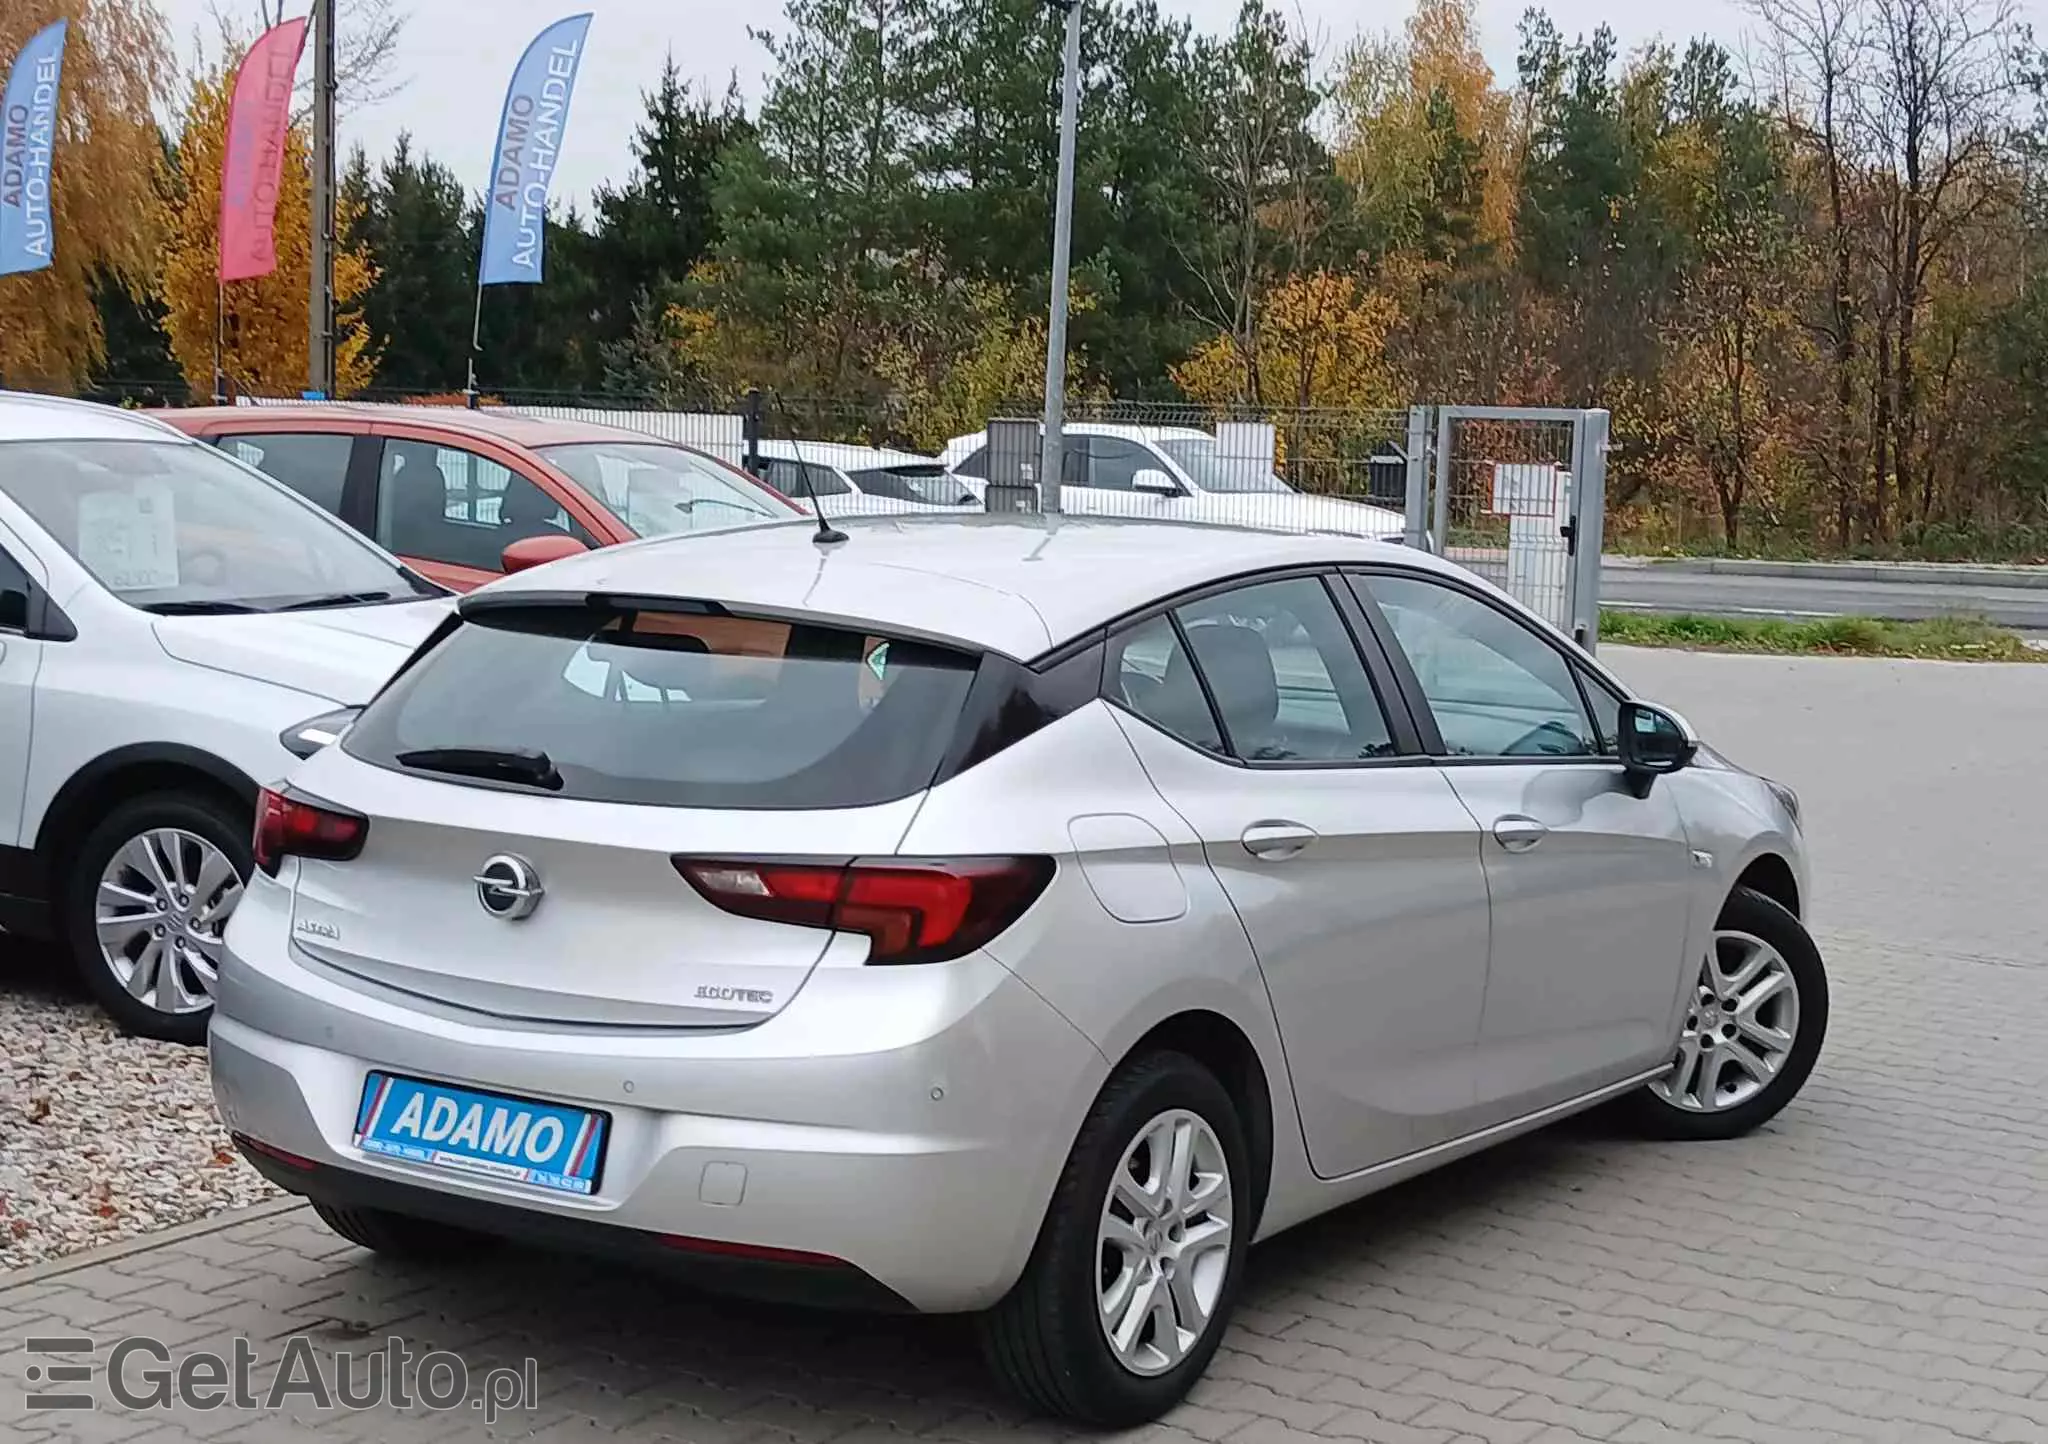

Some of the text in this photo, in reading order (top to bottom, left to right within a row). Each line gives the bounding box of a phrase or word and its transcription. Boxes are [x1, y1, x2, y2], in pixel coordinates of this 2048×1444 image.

[3, 104, 29, 209] ADAMO
[24, 52, 58, 257] AUTO-HANDEL
[495, 93, 535, 211] ADAMO
[511, 39, 579, 270] AUTO-HANDEL
[390, 1092, 564, 1164] ADAMO
